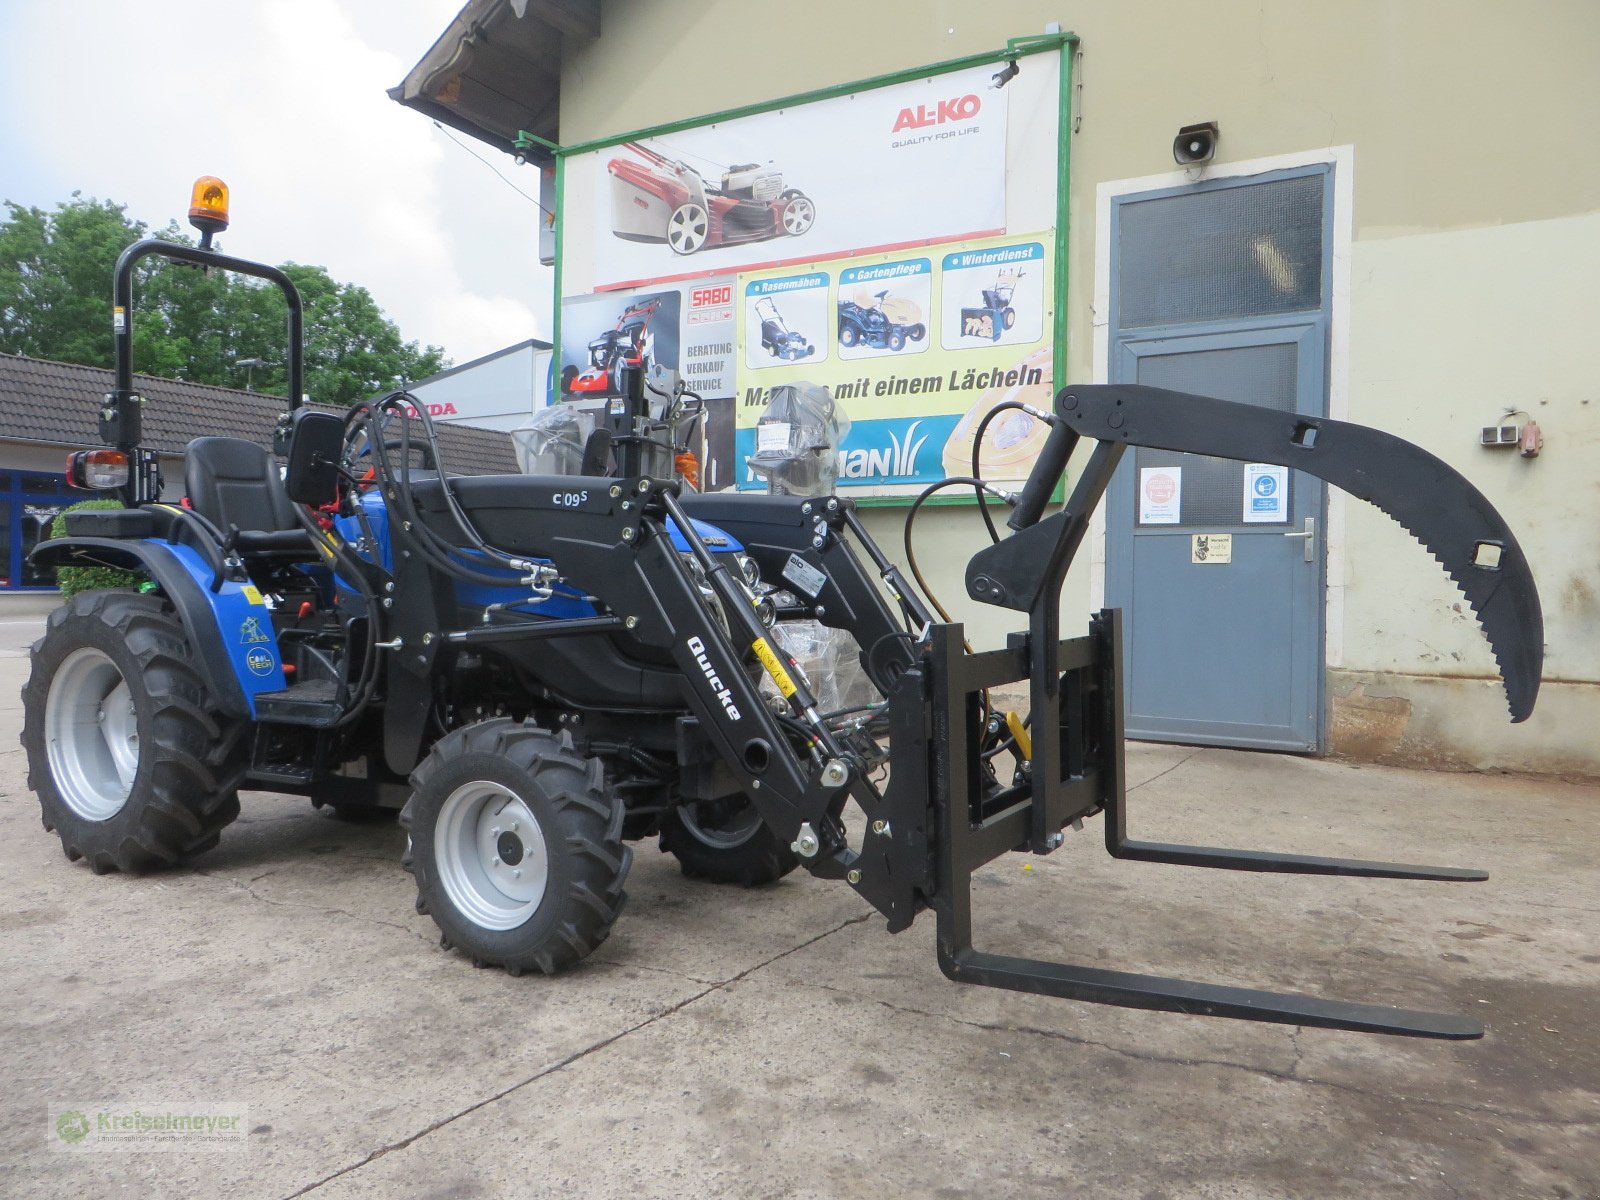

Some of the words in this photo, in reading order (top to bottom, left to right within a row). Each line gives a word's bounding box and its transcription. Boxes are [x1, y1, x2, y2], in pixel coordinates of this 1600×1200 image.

[892, 94, 981, 133] AL-KO
[892, 135, 933, 148] QUALITY
[935, 131, 956, 140] FOR
[958, 126, 980, 136] LIFE
[962, 247, 1033, 266] Winterdienst
[857, 263, 922, 281] Gartenpflege
[762, 277, 821, 293] Rasenmähen
[692, 287, 731, 307] SABO
[687, 342, 732, 358] BERATUNG
[686, 360, 725, 375] VERKAUF
[686, 378, 722, 392] SERVICE
[834, 377, 870, 400] mit
[874, 374, 942, 397] einem
[949, 364, 1043, 392] Lächeln
[388, 403, 457, 417] ODA
[687, 636, 741, 721] Quicke
